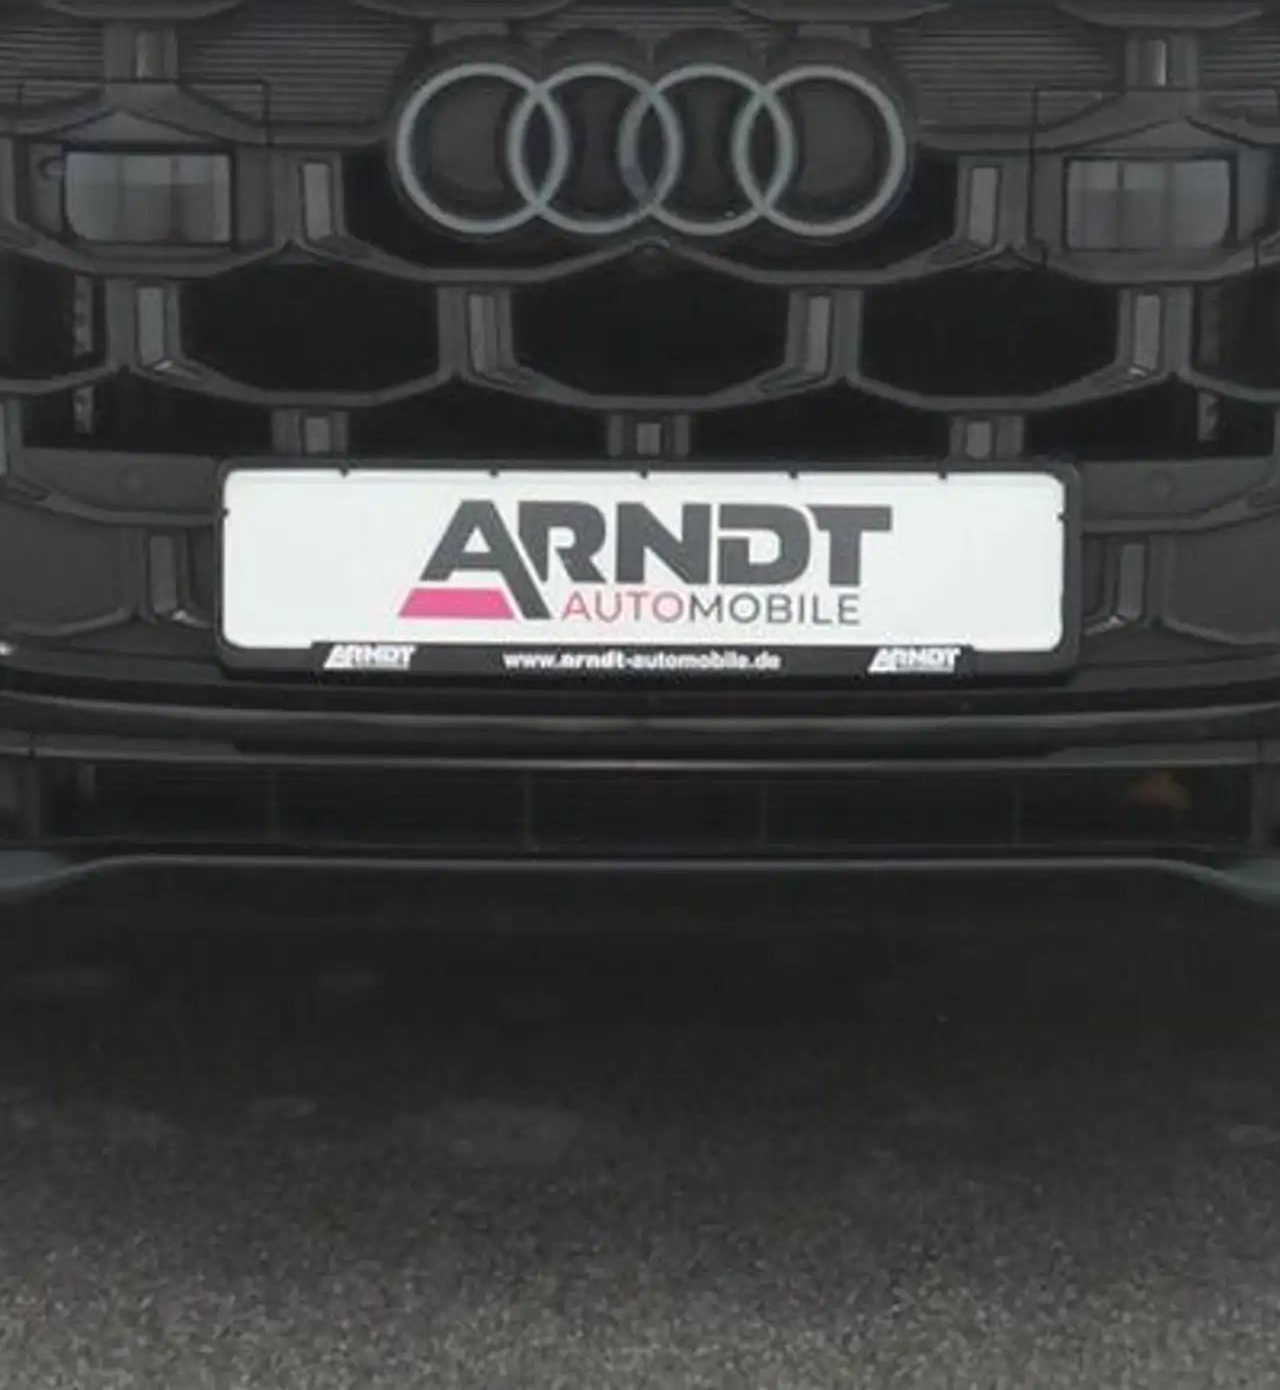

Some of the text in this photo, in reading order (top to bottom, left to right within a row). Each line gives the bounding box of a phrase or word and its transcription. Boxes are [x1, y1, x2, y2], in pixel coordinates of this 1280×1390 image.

[418, 499, 893, 620] ARNDT
[561, 590, 861, 625] AUTOMOBILE
[502, 649, 781, 670] www.arndt-automobile.de
